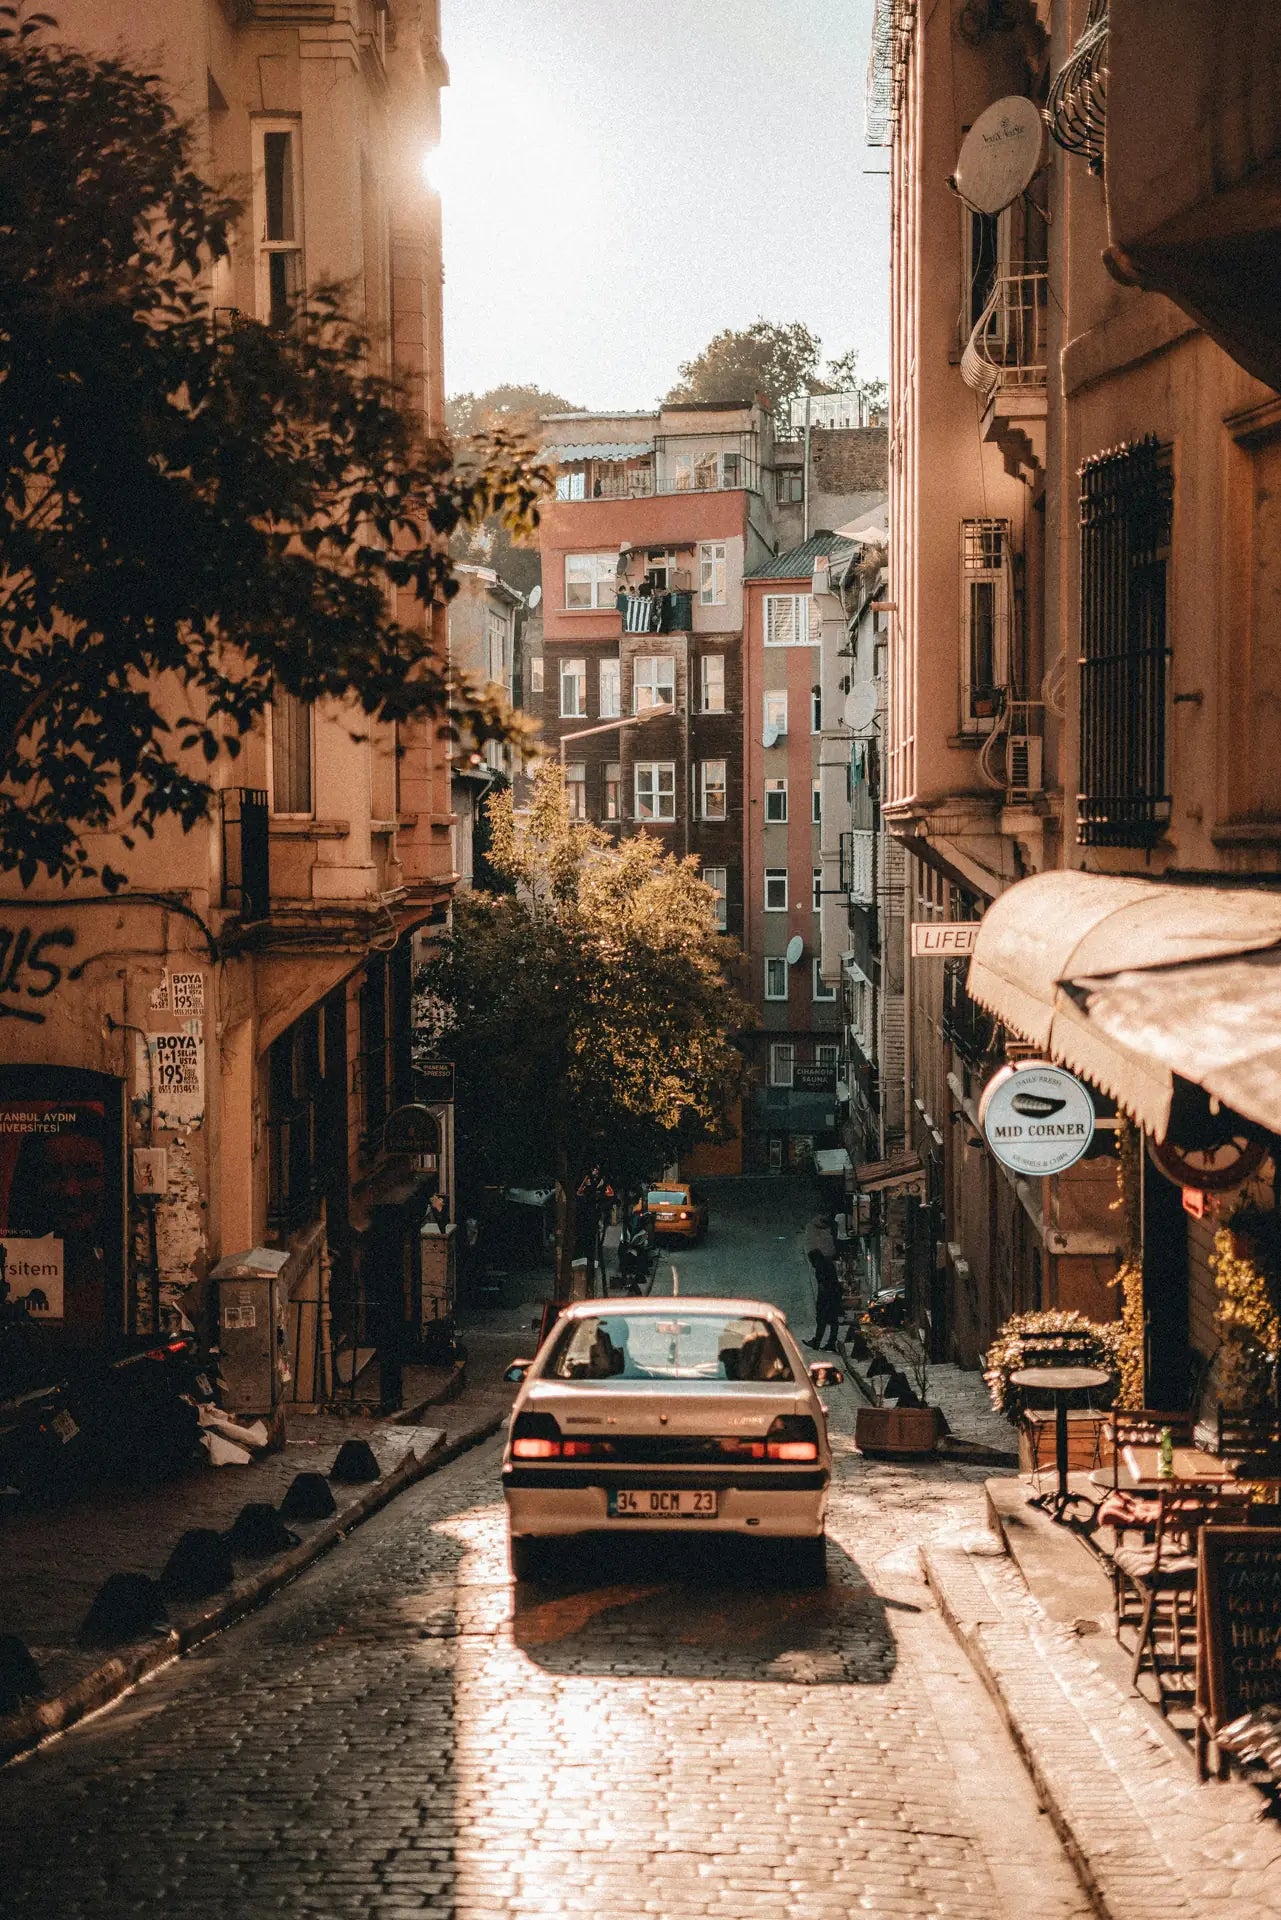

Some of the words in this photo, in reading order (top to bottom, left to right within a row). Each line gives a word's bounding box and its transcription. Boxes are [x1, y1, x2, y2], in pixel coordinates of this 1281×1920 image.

[924, 930, 978, 949] LIFEI
[172, 974, 202, 984] BOYA
[174, 985, 187, 996] 1+1
[174, 996, 192, 1009] 195
[157, 1036, 197, 1050] BOYA
[158, 1050, 176, 1064] 1+1
[158, 1065, 183, 1085] 195
[1015, 1076, 1037, 1088] DAILY
[1038, 1076, 1062, 1087] FRESH
[43, 1112, 77, 1122] AYDIN
[994, 1126, 1023, 1138] MID
[1028, 1123, 1086, 1137] CORNER
[618, 1492, 637, 1511] 34
[693, 1492, 713, 1511] 23
